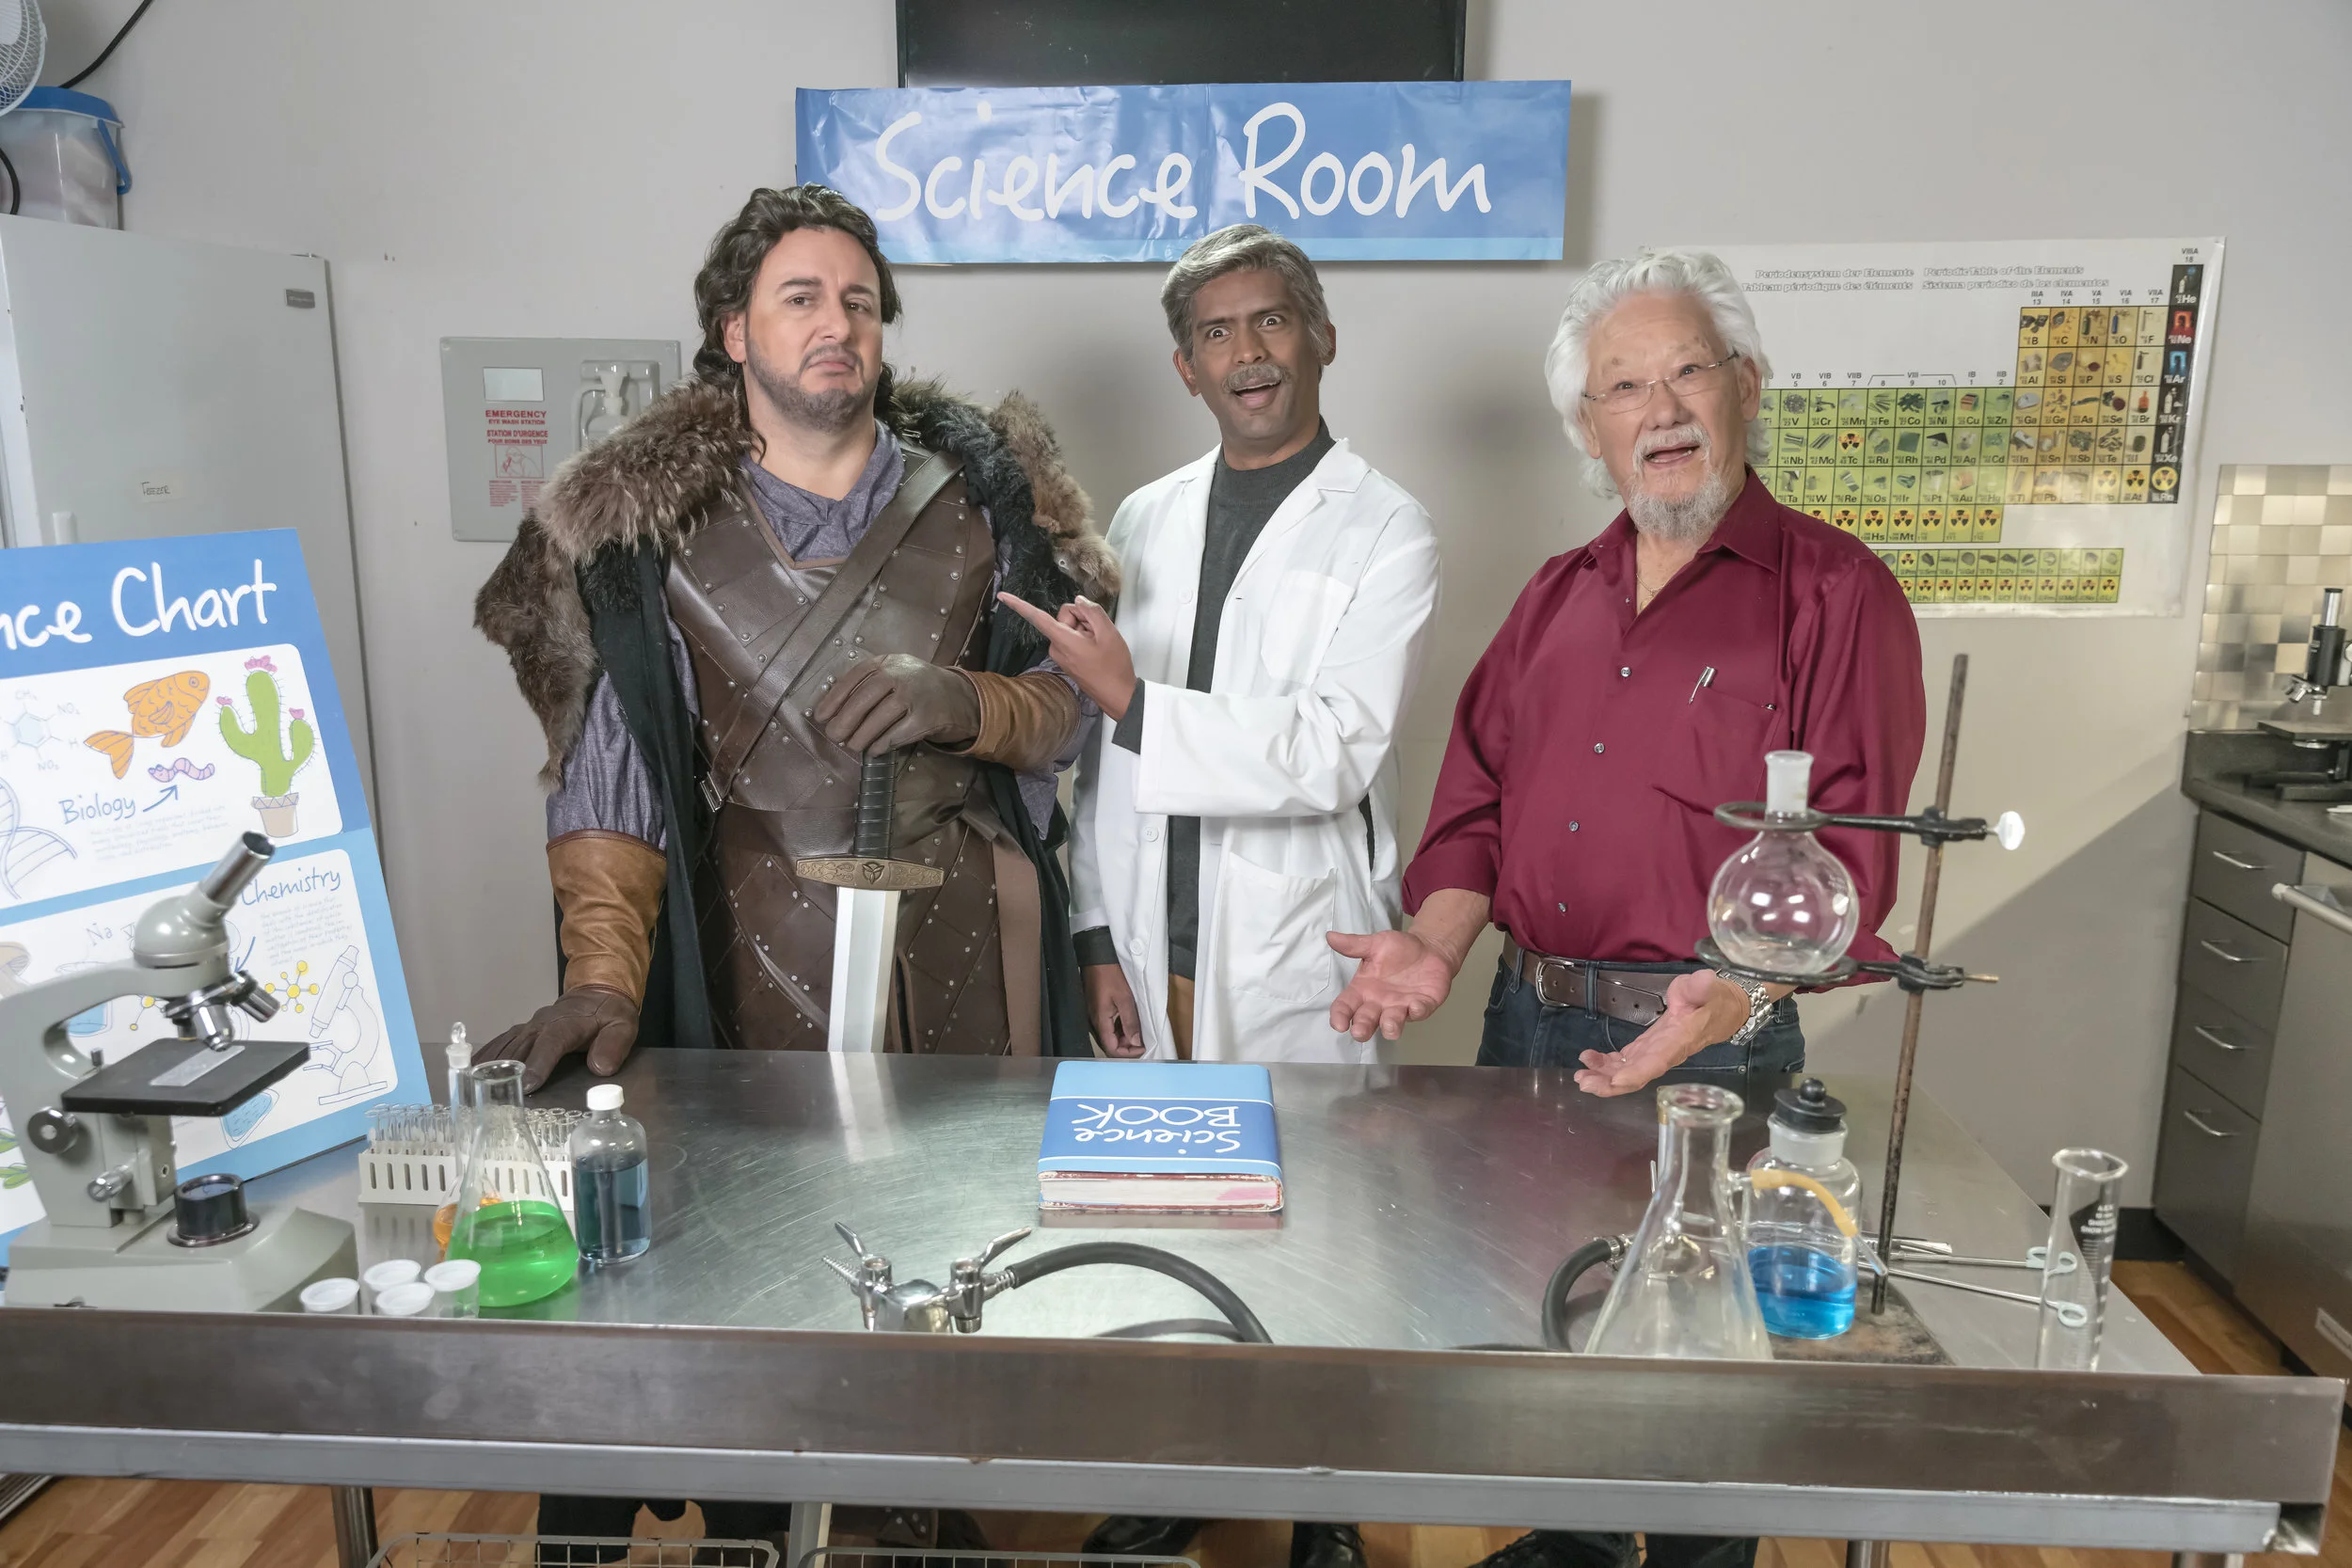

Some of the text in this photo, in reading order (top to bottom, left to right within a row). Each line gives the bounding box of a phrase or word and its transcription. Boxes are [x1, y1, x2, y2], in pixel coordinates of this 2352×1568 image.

[875, 100, 1491, 222] Science Room
[1843, 269, 1862, 277] der
[1864, 268, 1915, 277] Elemente
[1924, 267, 1968, 277] Periodic
[1970, 266, 1998, 276] Table
[2014, 266, 2032, 276] the
[2034, 265, 2085, 275] Elements
[1922, 280, 1965, 290] Sistema
[2020, 279, 2034, 288] de
[2036, 279, 2051, 288] los
[2054, 278, 2109, 288] elementos
[2183, 294, 2197, 304] He
[2060, 336, 2068, 344] C
[2090, 336, 2098, 344] N
[2118, 336, 2126, 344] O
[2176, 334, 2191, 344] Ne
[2173, 374, 2185, 383] Ar
[485, 410, 547, 419] EMERGENCY
[2168, 415, 2180, 423] Kr
[1790, 456, 1804, 465] Nb
[1819, 456, 1835, 465] Mo
[1963, 455, 1976, 466] Ag
[2106, 454, 2117, 463] Te
[2164, 454, 2177, 463] Xe
[111, 558, 278, 638] Chart
[58, 792, 136, 825] Biology
[241, 866, 342, 906] Chemistry
[1071, 1103, 1241, 1130] BOOK
[1073, 1128, 1241, 1154] Science
